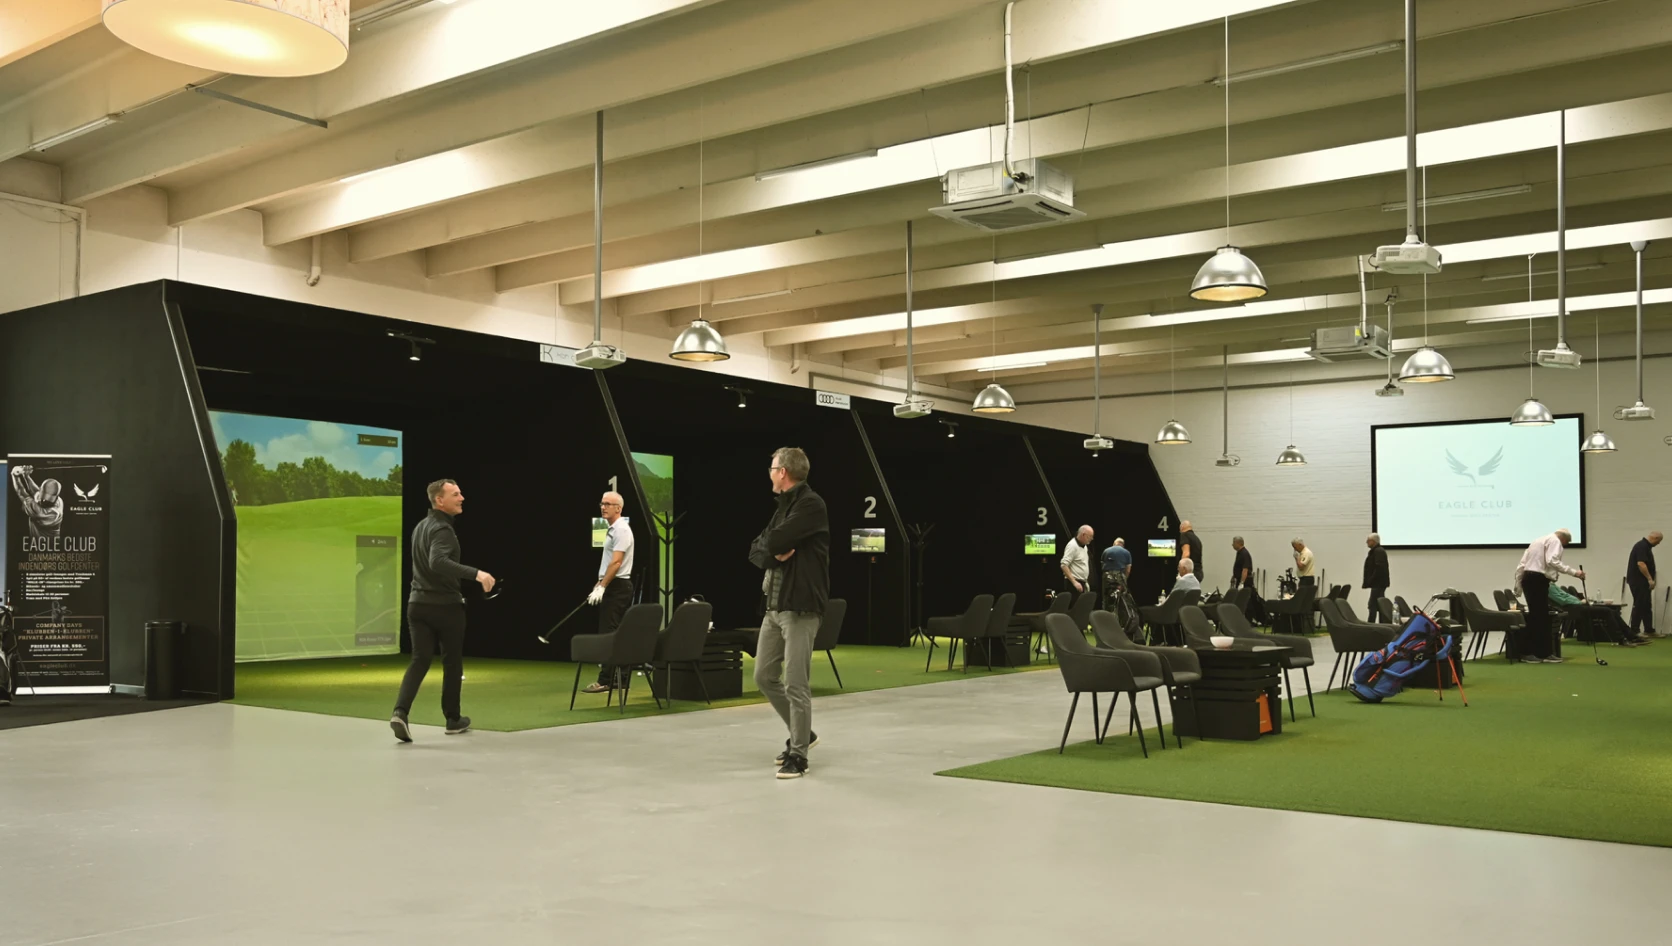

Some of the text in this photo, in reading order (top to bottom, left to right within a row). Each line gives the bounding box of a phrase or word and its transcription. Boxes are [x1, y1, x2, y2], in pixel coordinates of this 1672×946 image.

[608, 475, 617, 493] 1
[864, 496, 877, 518] 2
[1438, 500, 1512, 509] EAGLE CLUB
[1037, 507, 1048, 526] 3
[1157, 516, 1169, 531] 4
[22, 536, 97, 552] EAGLE CLUB
[28, 553, 91, 561] DANMARKS BEDSTE
[18, 562, 100, 571] INDENDØRS GOLFCENTER
